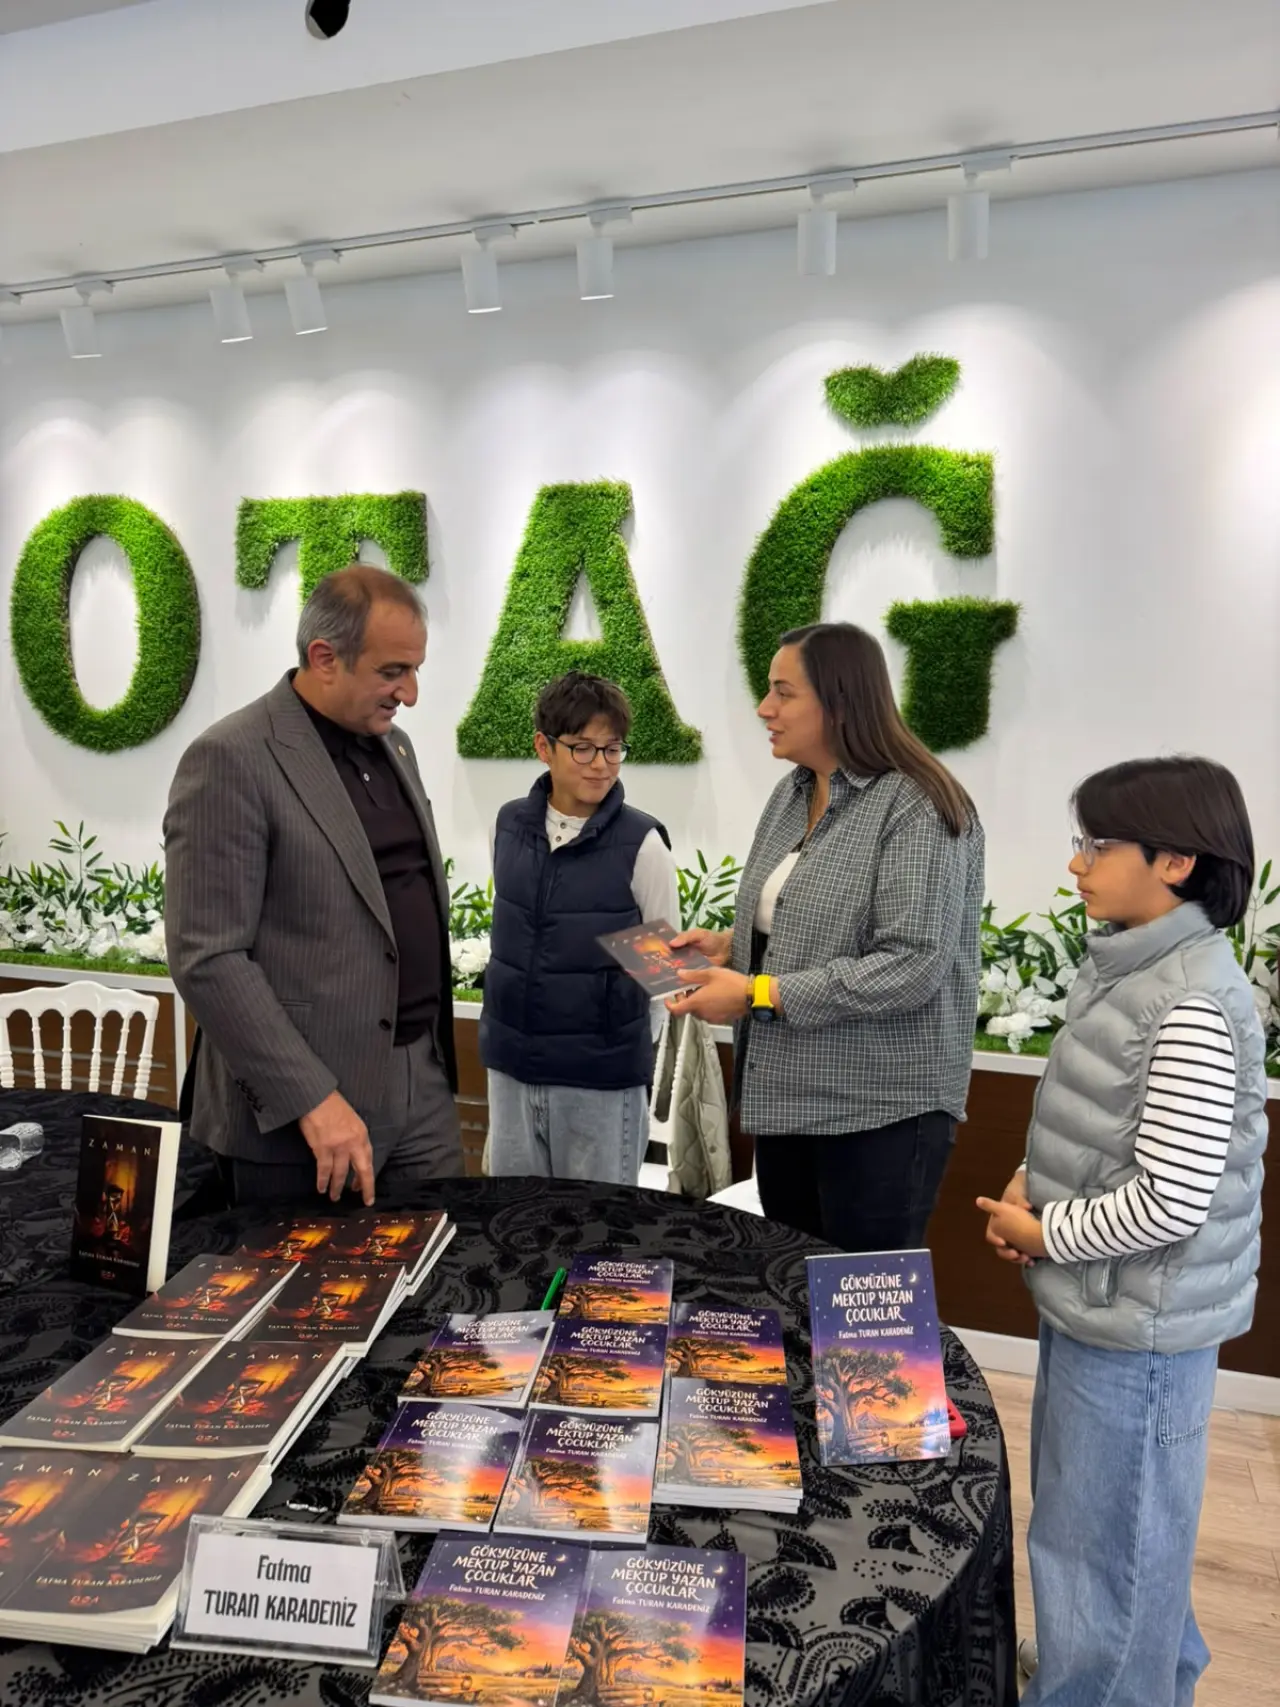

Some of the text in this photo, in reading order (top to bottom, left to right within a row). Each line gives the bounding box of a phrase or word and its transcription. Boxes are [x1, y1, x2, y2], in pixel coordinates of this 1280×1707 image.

[88, 1138, 151, 1156] ZAMAN
[198, 1262, 280, 1274] ZAMAN
[303, 1272, 388, 1280] ZAMAN
[841, 1272, 902, 1291] GÖKYÜZÜNE
[832, 1290, 913, 1308] MEKTUP YAZAN
[688, 1315, 761, 1327] MEKTUP YAZAN
[846, 1306, 906, 1327] ÇOCUKLAR
[570, 1331, 646, 1344] MEKTUP YAZAN
[858, 1328, 879, 1338] TURAN
[106, 1347, 199, 1357] ZAMAN
[580, 1339, 635, 1350] ÇOCUKLAR
[227, 1352, 323, 1360] ZAMAN
[696, 1387, 758, 1400] GÖKYÜZÜNE
[685, 1394, 769, 1409] MEKTUP YAZAN
[698, 1403, 760, 1416] ÇOCUKLAR
[411, 1419, 499, 1434] MEKTUP YAZAN
[559, 1420, 624, 1434] GÖKYÜZÜNE
[421, 1428, 484, 1444] ÇOCUKLAR
[546, 1427, 634, 1442] MEKTUP YAZAN
[557, 1437, 621, 1452] ÇOCUKLAR
[0, 1462, 102, 1477] AMAN
[128, 1470, 241, 1484] ZAMAN
[470, 1544, 548, 1563] GÖKYÜZÜNE
[256, 1554, 312, 1584] Fatma
[452, 1555, 557, 1577] MEKTUP YAZAN
[626, 1556, 705, 1575] GÖKYÜZÜNE
[36, 1575, 68, 1586] FATMA
[70, 1578, 105, 1587] TURAN
[464, 1569, 539, 1590] ÇOCUKLAR
[611, 1568, 716, 1589] MEKTUP YAZAN
[449, 1583, 473, 1593] Fatma
[474, 1586, 500, 1596] TURAN
[625, 1581, 702, 1601] ÇOCUKLAR
[204, 1589, 358, 1628] TURAN KARADENİZ
[638, 1598, 665, 1608] TURAN
